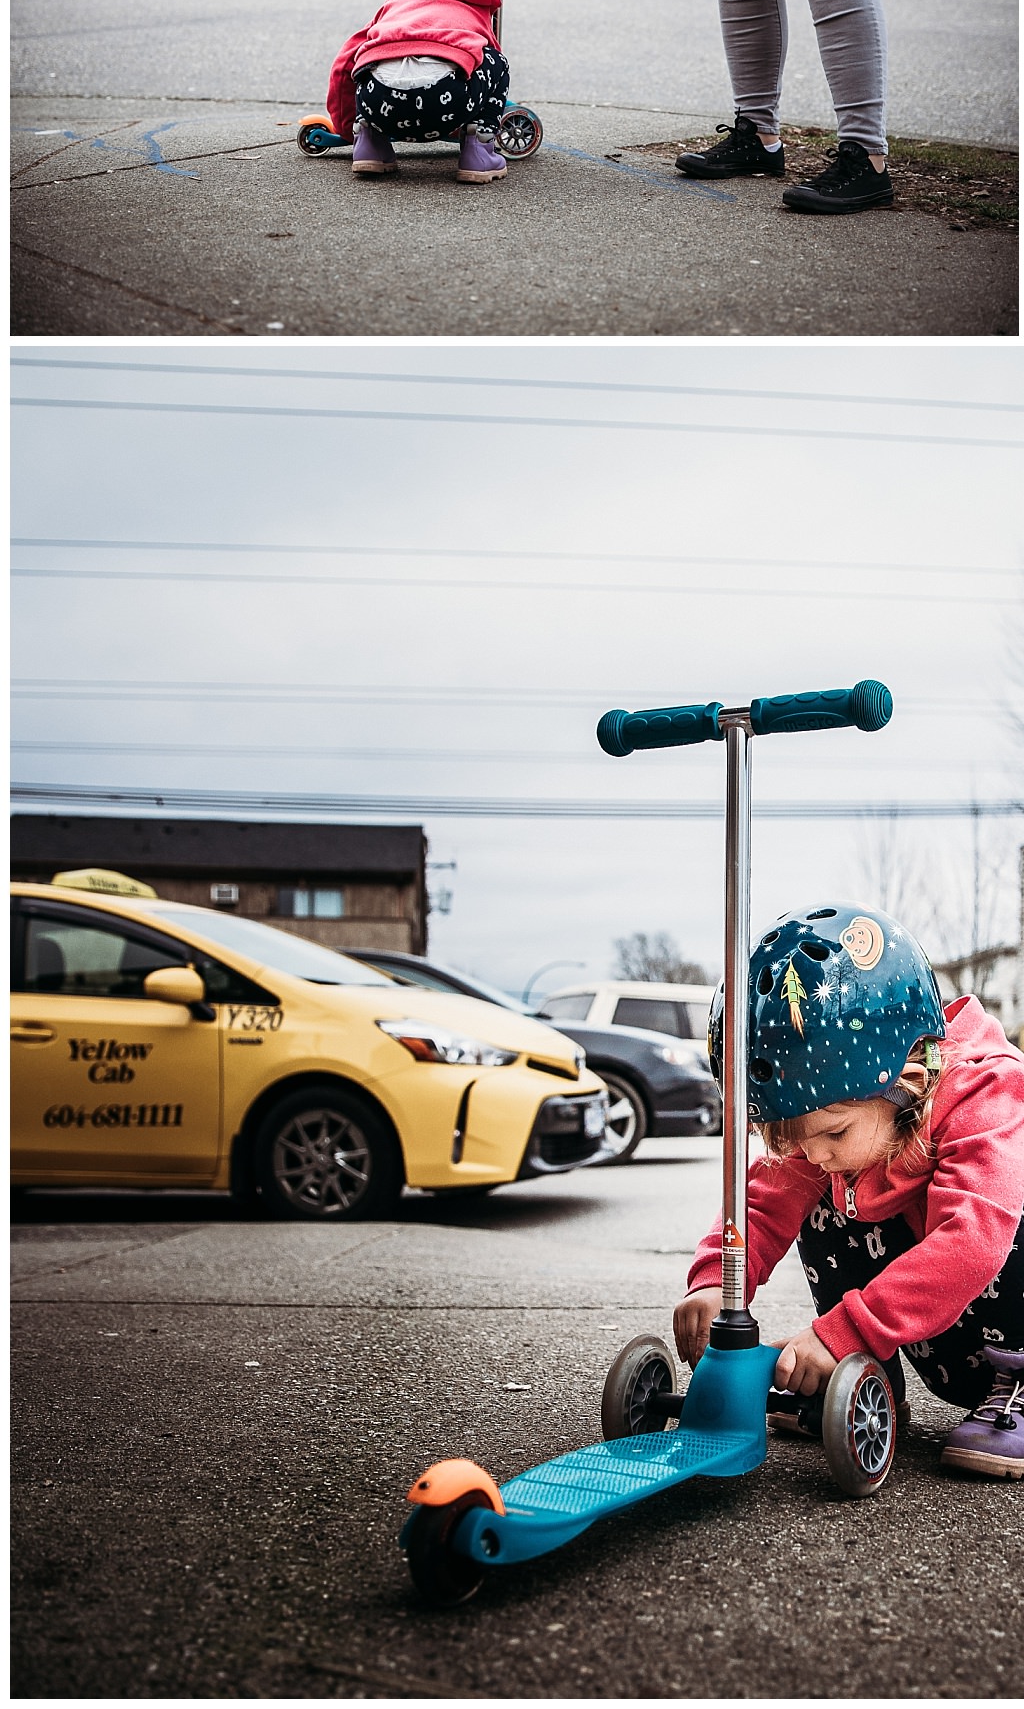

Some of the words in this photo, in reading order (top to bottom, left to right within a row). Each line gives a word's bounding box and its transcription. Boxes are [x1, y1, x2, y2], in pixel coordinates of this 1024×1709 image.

[227, 1007, 284, 1032] Y320
[68, 1039, 153, 1061] Yellow
[87, 1061, 135, 1084] Cab
